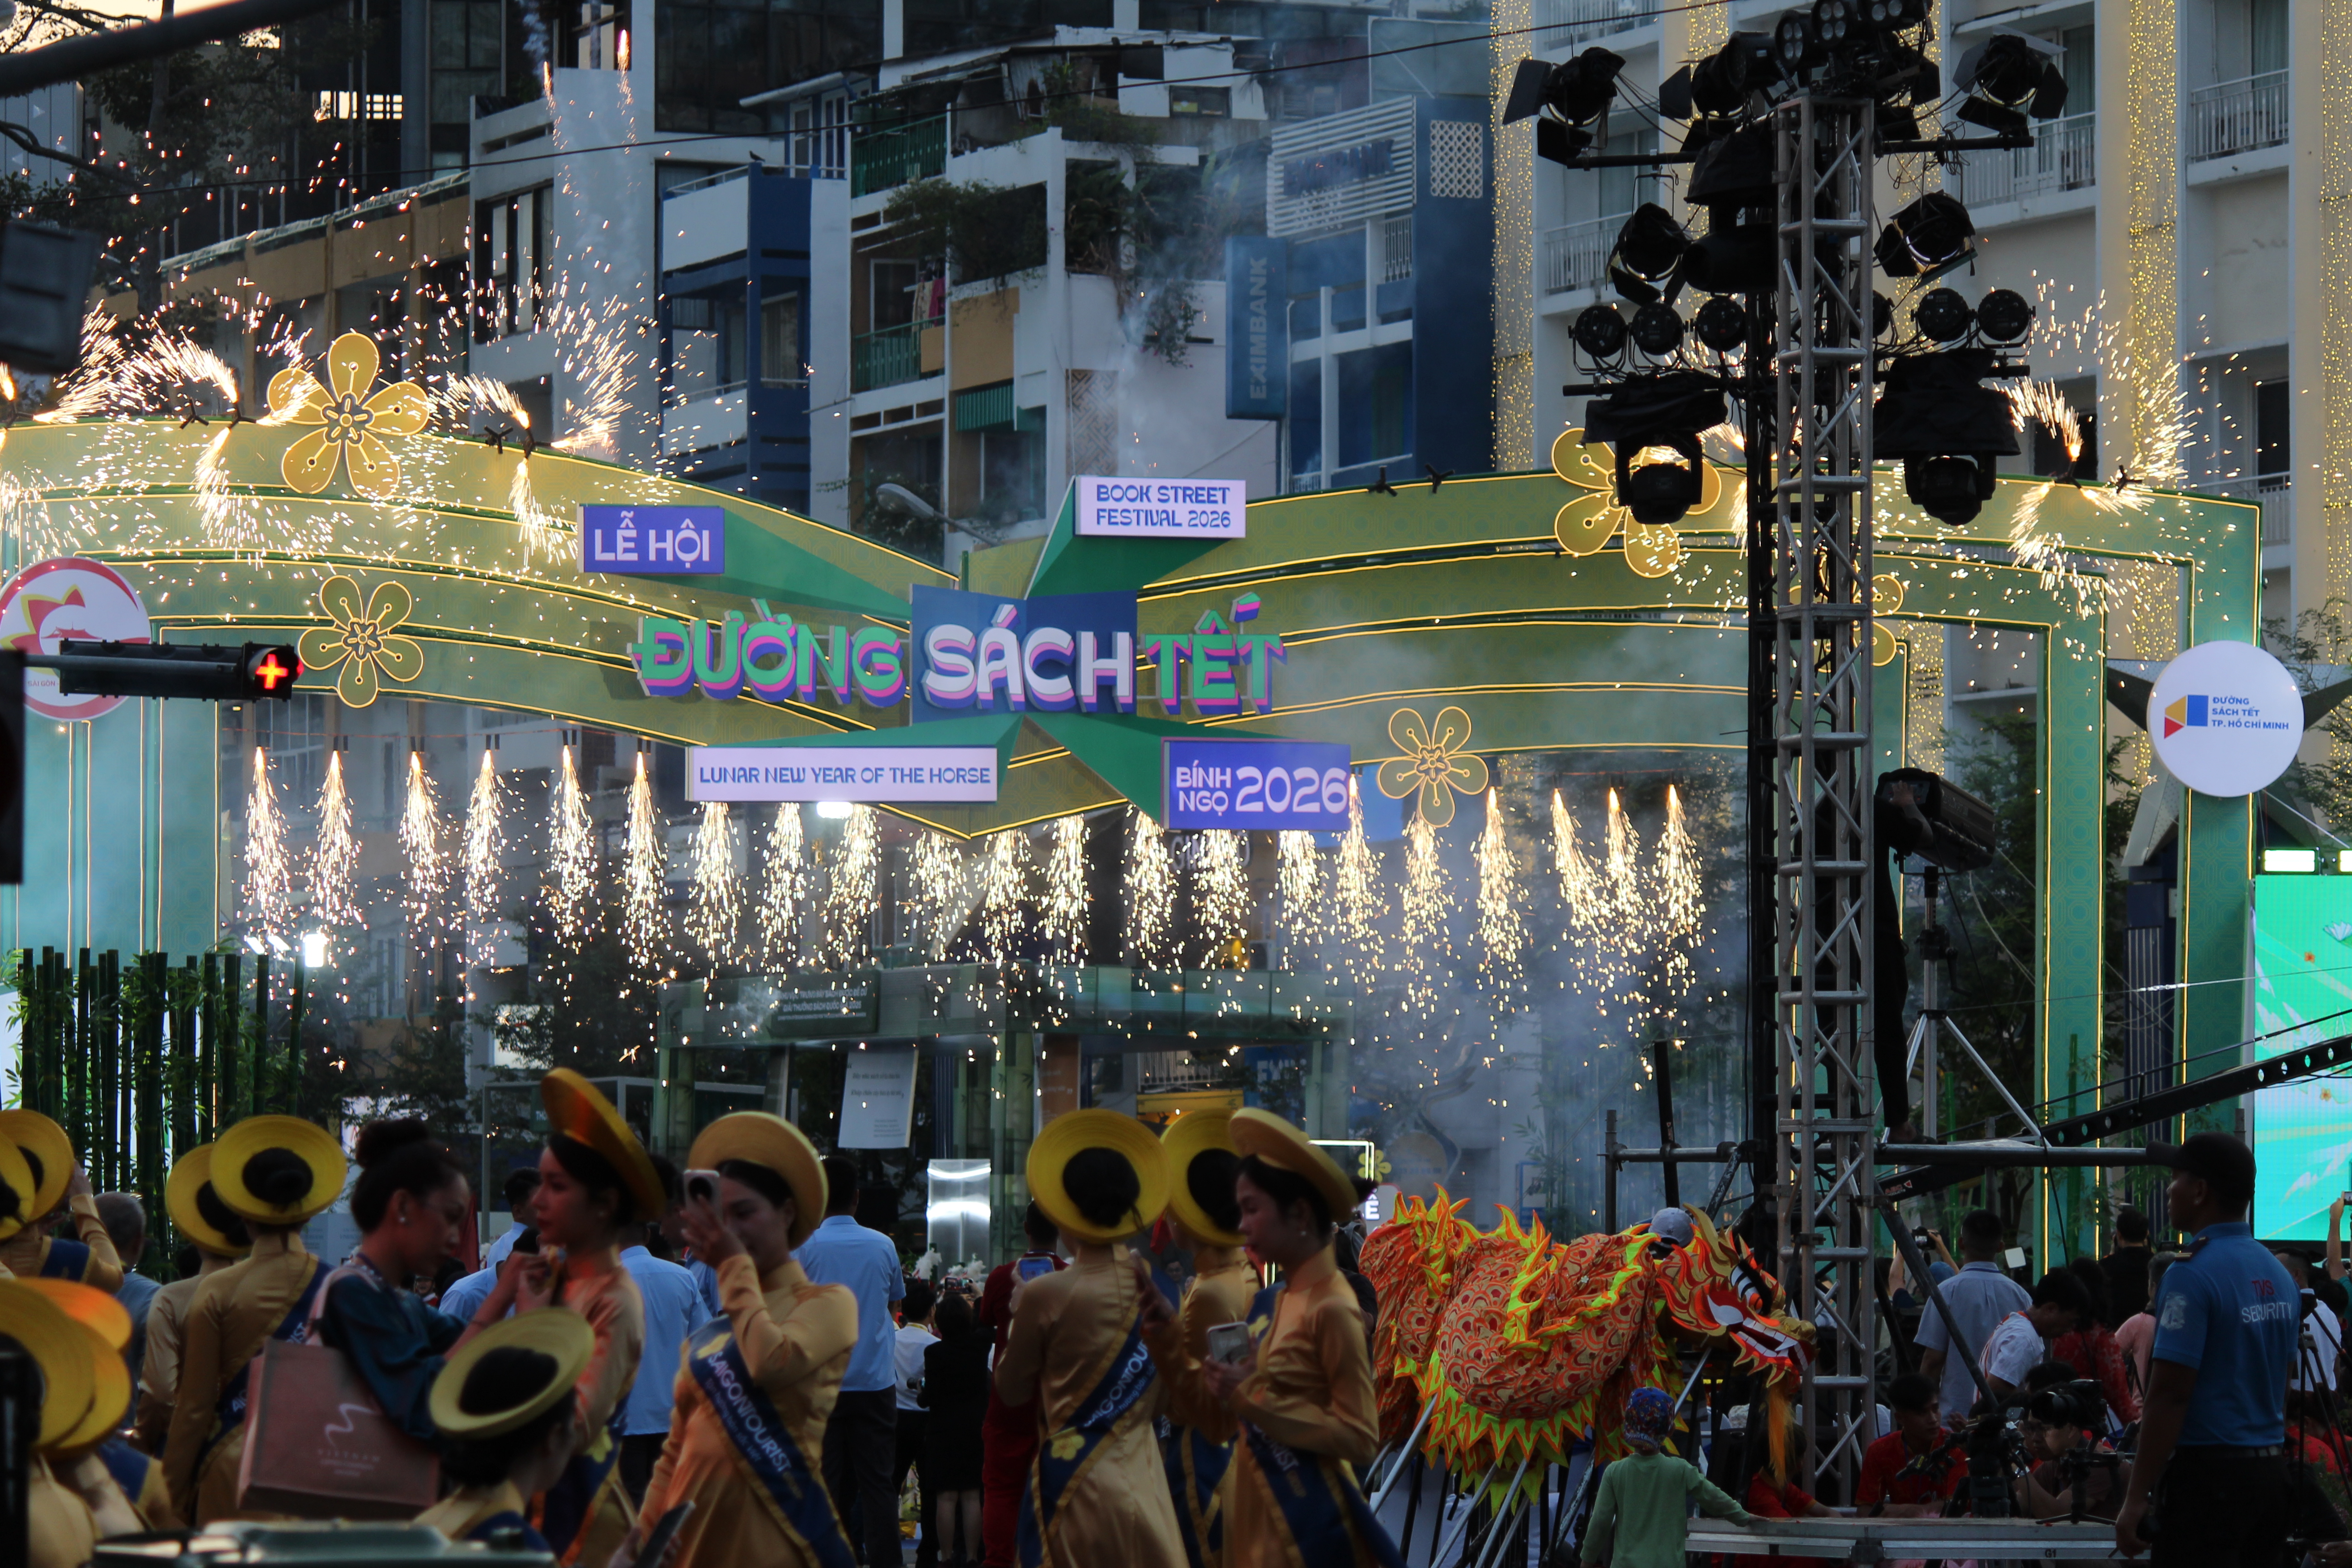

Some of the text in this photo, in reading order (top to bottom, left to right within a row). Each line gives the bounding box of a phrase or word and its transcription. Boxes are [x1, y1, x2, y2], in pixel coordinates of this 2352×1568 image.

[1250, 257, 1267, 400] EXIMBANK
[1097, 484, 1230, 504] BOOK STREET
[1097, 508, 1231, 528] FESTIVAL 2026
[595, 510, 710, 568] LỄ HỘI
[627, 592, 1287, 715] ĐƯỜNG SÁCH TẾT
[2213, 696, 2249, 705] ĐƯỜNG
[2212, 706, 2260, 717] SÁCH TẾT
[2228, 718, 2242, 728] HỒ
[2244, 720, 2261, 729] CHÍ
[700, 767, 991, 784] LUNAR NEW YEAR OF THE HORSE
[1176, 760, 1348, 813] BÍNH 2026
[1179, 790, 1229, 816] NGỌ
[2251, 1279, 2274, 1297] TVS
[2241, 1302, 2291, 1323] SECURITY
[708, 1351, 791, 1473] SAIGONTOURIST
[2045, 1548, 2056, 1558] G1
